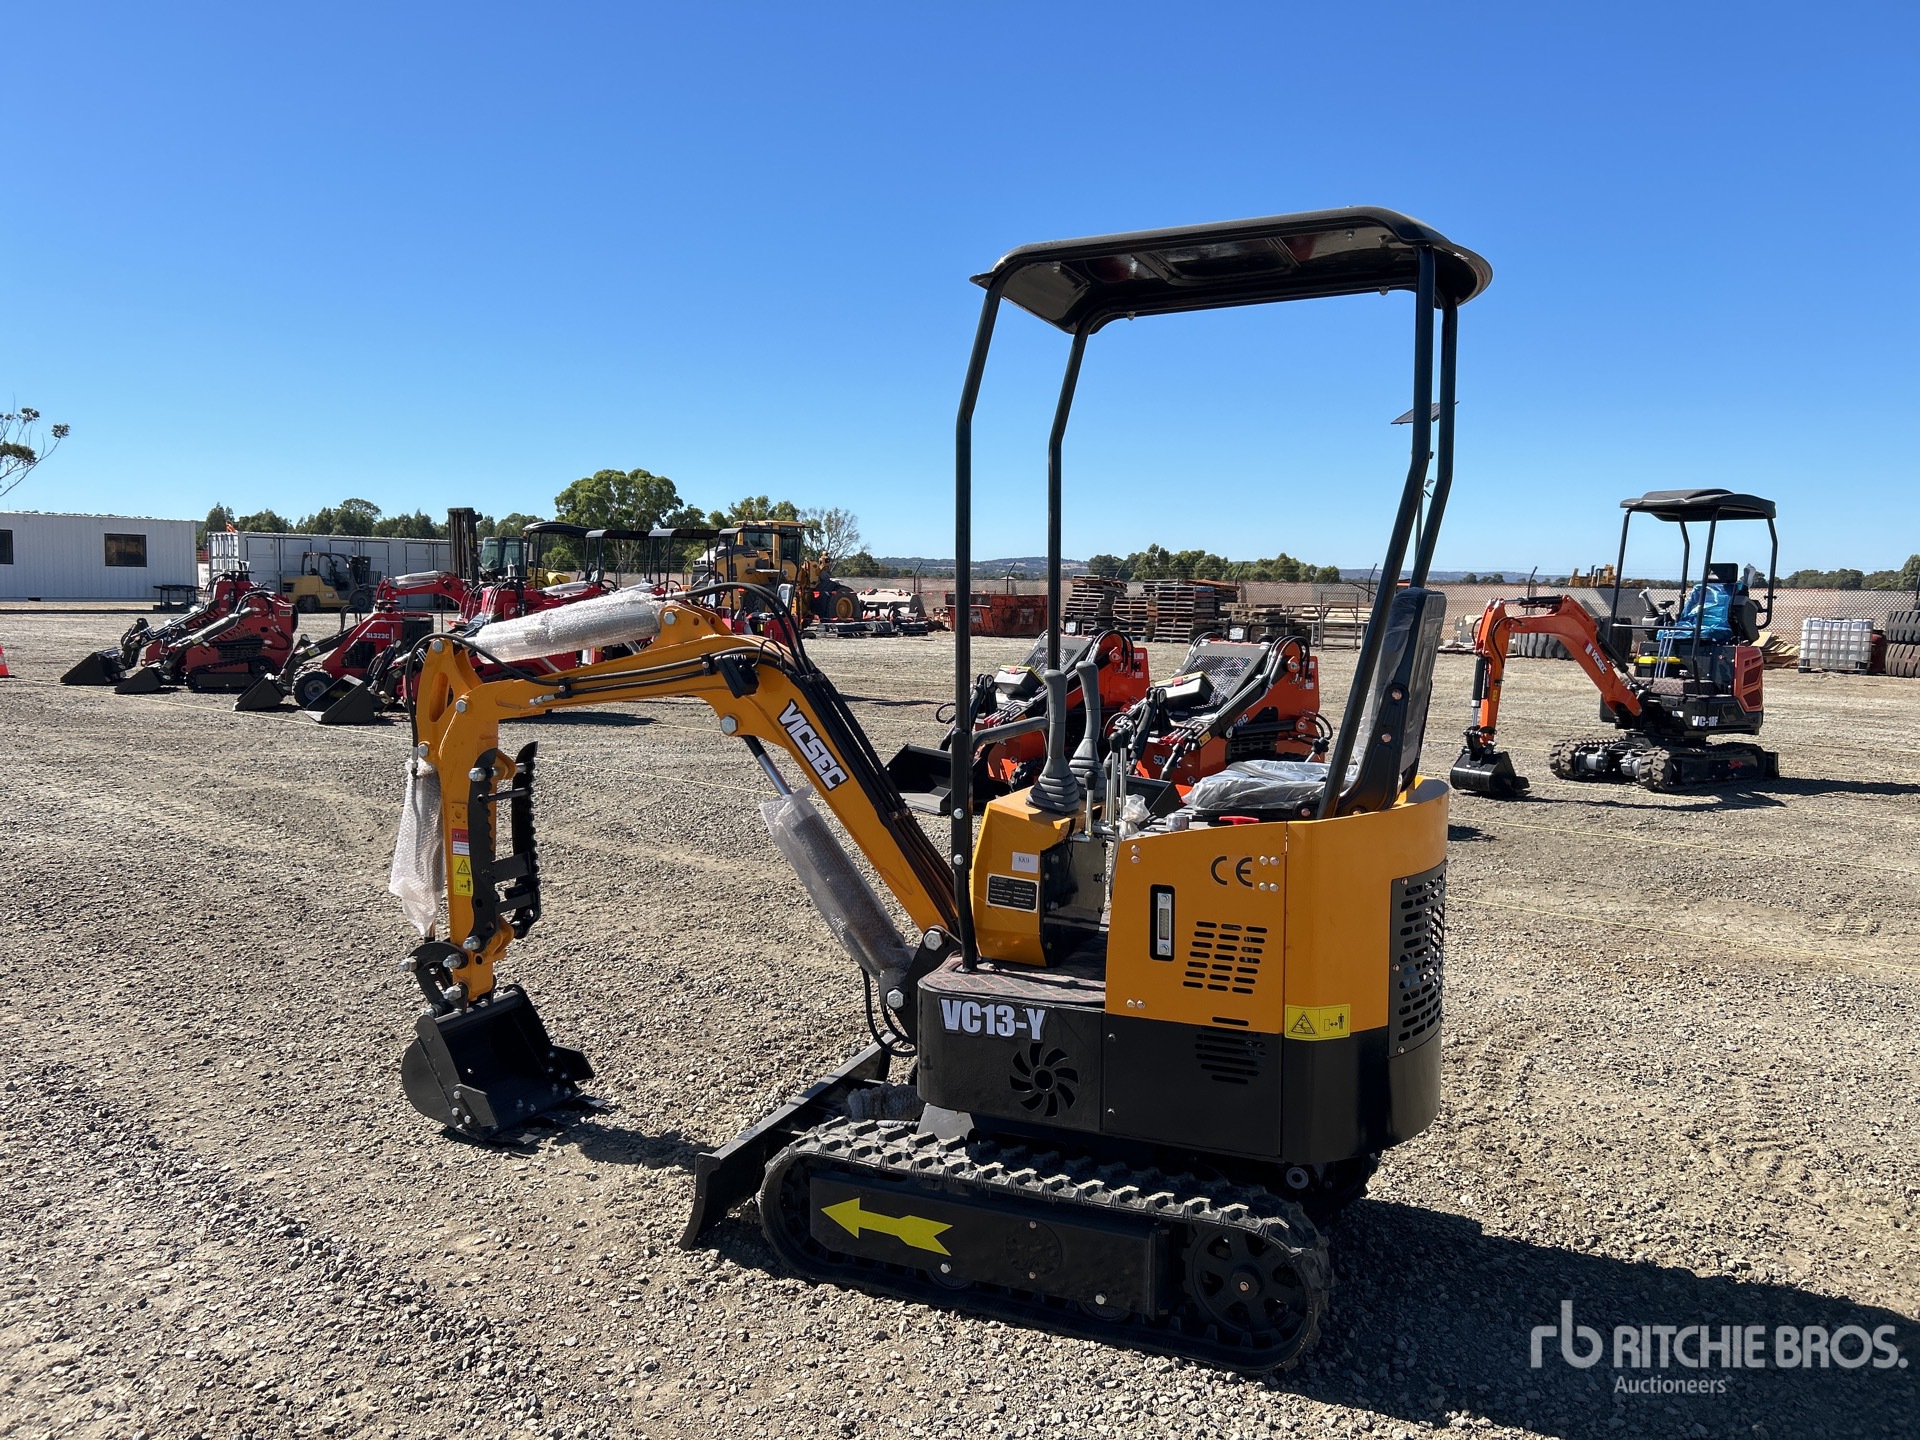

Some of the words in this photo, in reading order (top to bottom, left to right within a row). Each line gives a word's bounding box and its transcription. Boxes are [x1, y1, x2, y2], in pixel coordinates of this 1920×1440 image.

[366, 632, 390, 640] SL323C
[779, 701, 847, 790] VICSEC
[1210, 855, 1253, 888] CE
[940, 998, 1046, 1041] VC13-Y
